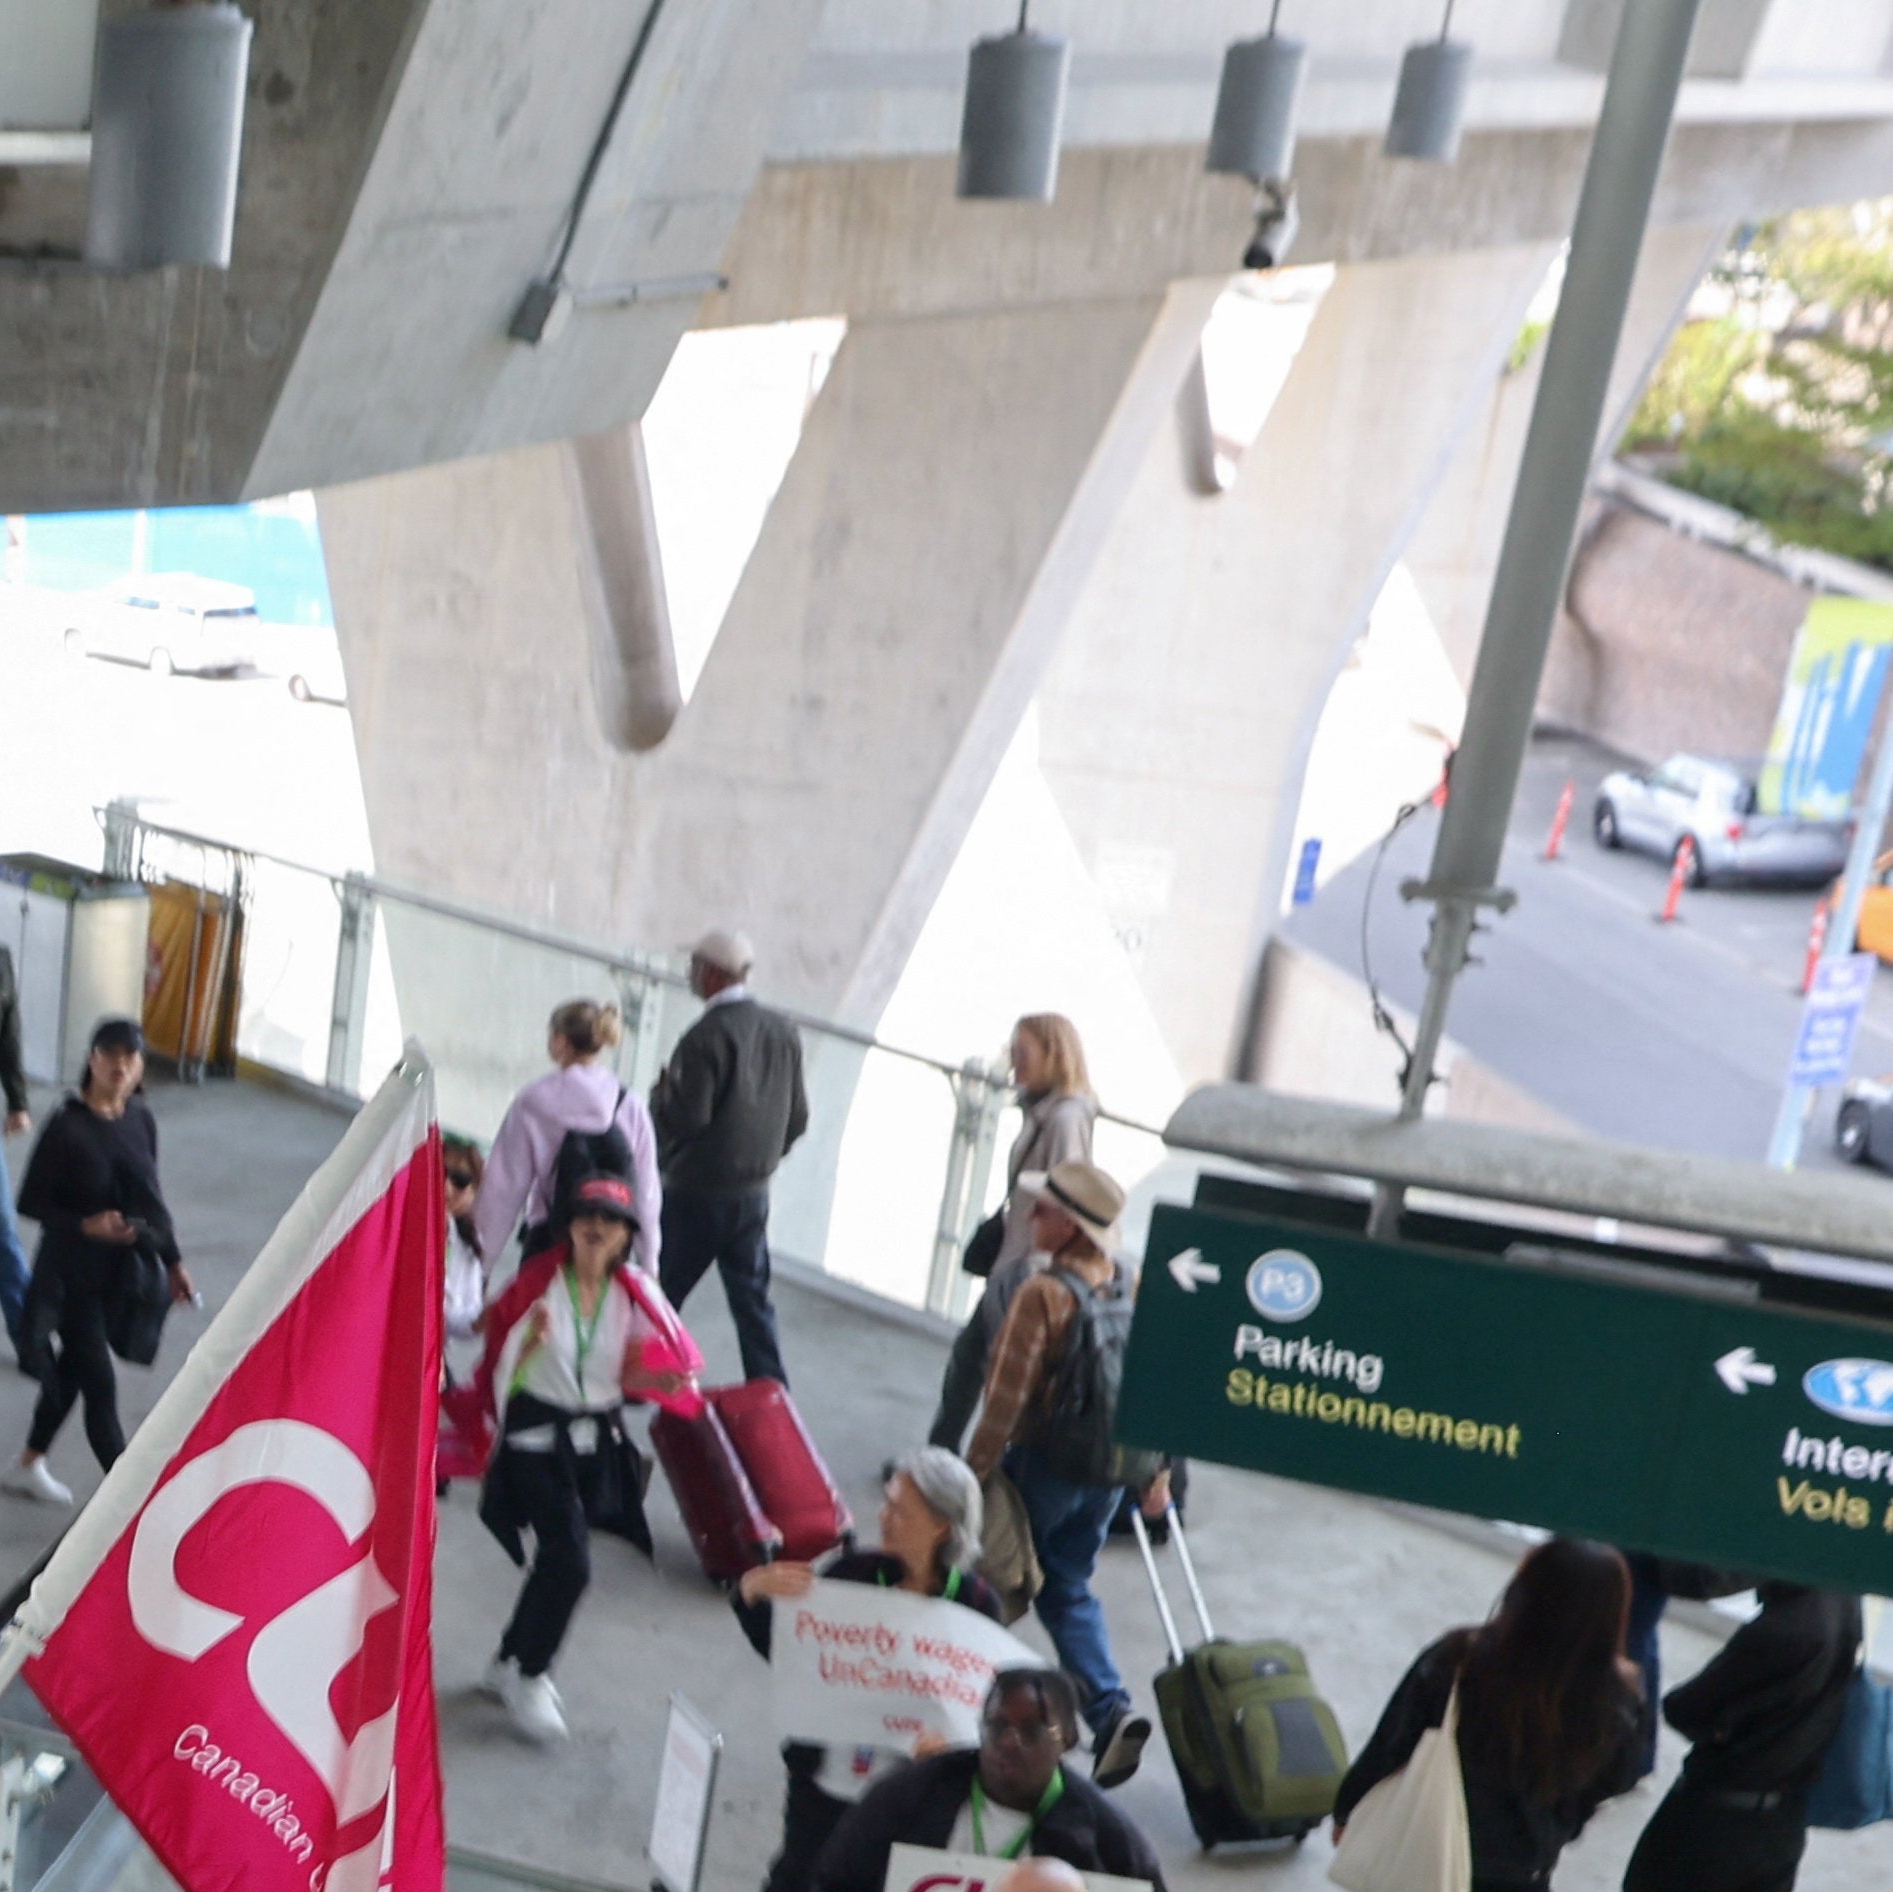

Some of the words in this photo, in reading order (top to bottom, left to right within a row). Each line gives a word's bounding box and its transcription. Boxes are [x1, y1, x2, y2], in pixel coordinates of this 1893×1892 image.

[1261, 1266, 1307, 1301] P3
[1233, 1322, 1385, 1395] Parking
[1224, 1366, 1522, 1460] Stationnement
[1781, 1426, 1893, 1486] Inter
[1776, 1474, 1871, 1530] Vols
[795, 1609, 899, 1657] Poverty
[172, 1722, 315, 1866] Canadian
